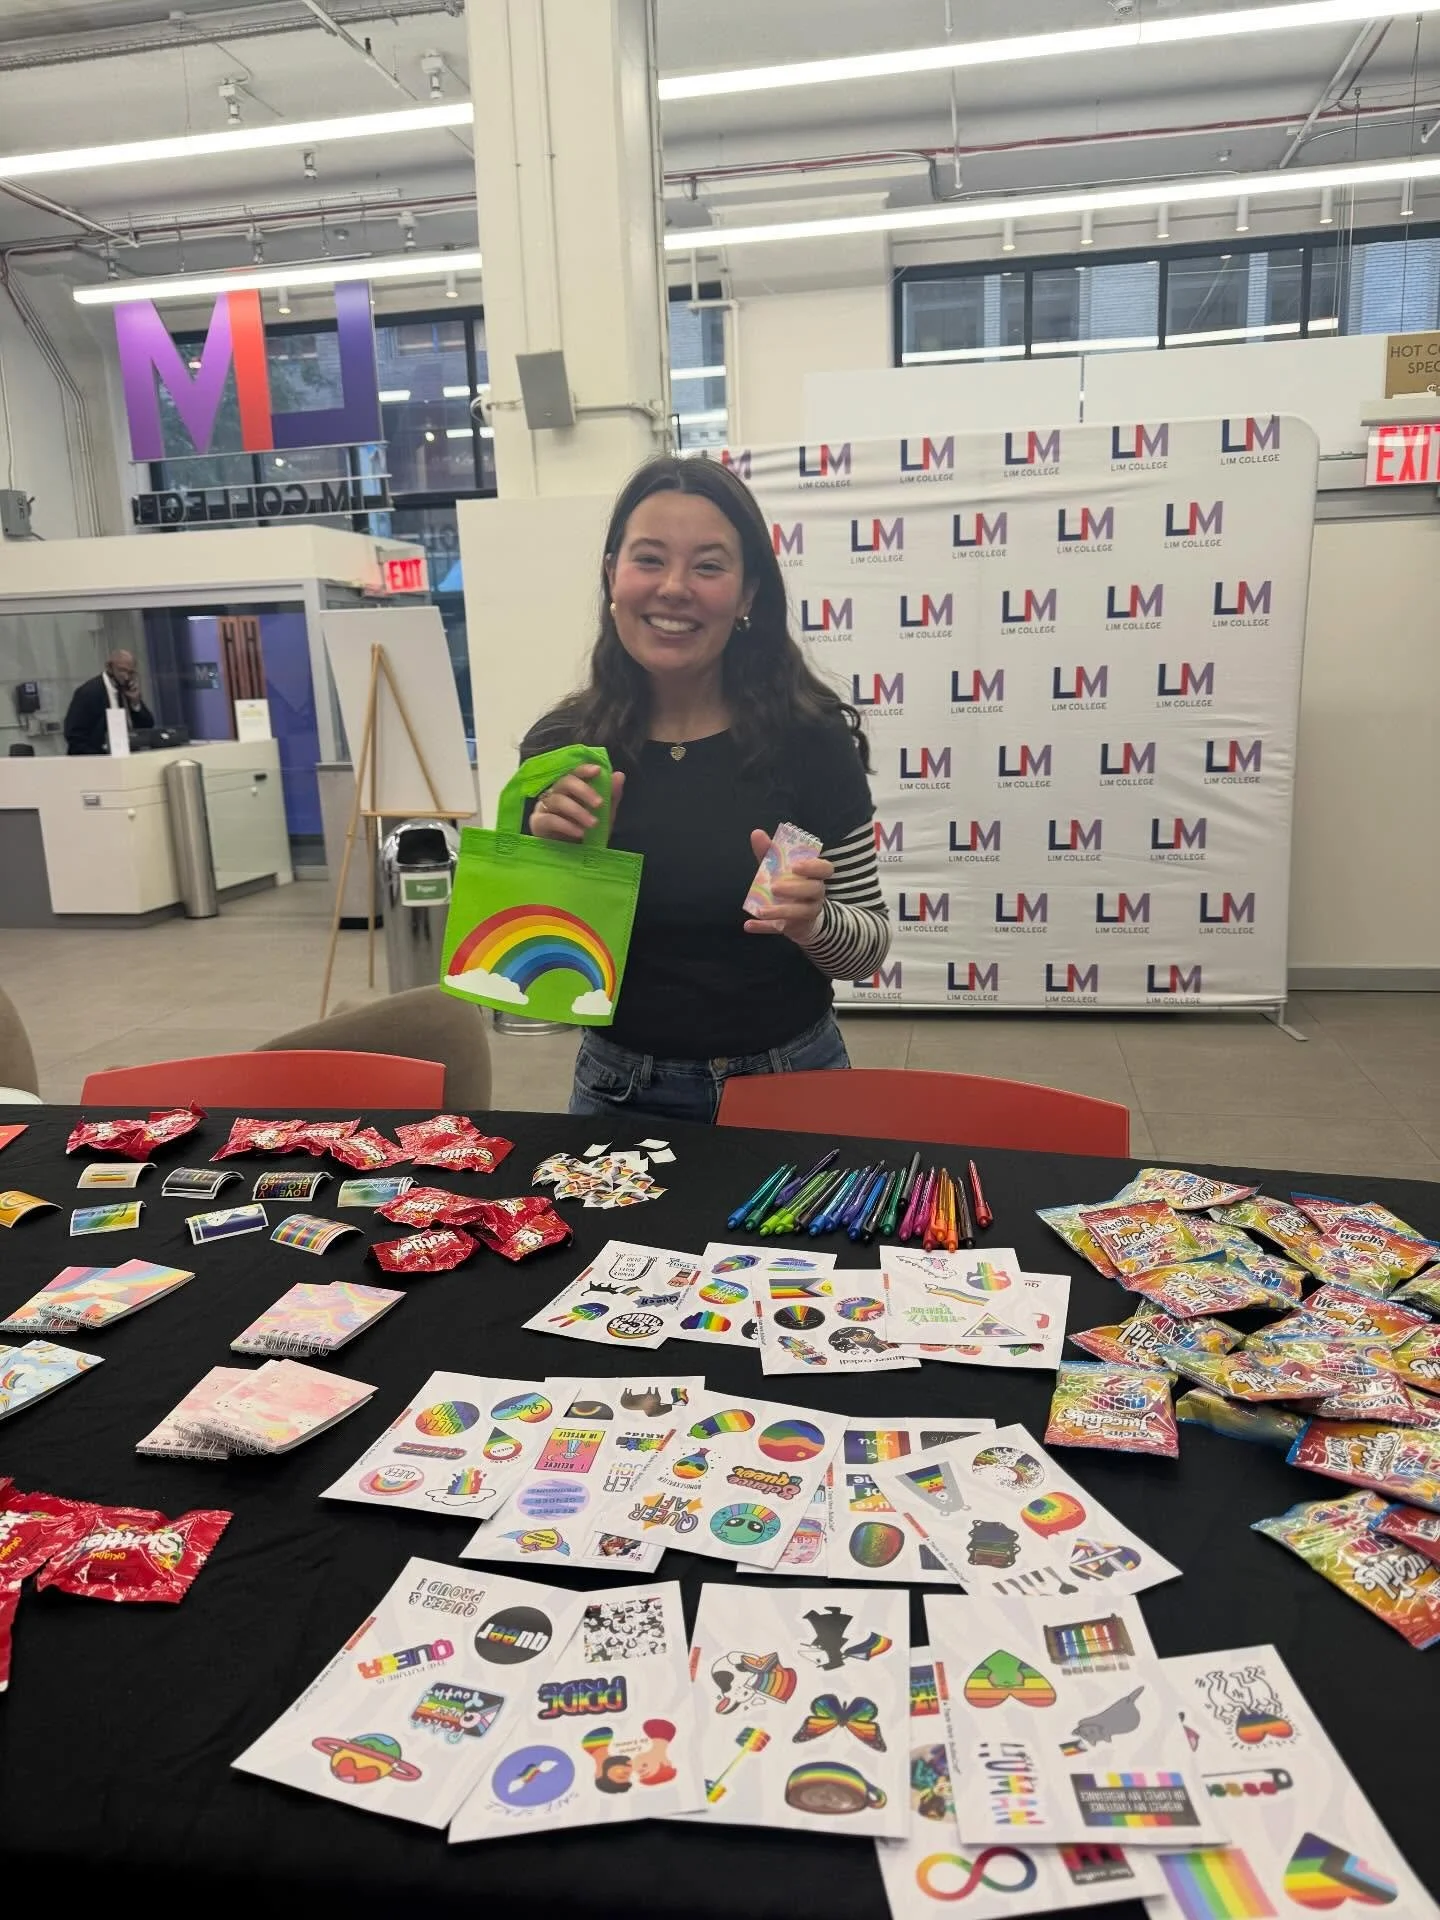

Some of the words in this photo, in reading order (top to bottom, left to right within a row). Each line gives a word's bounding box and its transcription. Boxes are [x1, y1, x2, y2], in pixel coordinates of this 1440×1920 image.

[1390, 345, 1423, 358] HOT
[1239, 455, 1279, 463] COLLEGE
[1128, 462, 1167, 470] COLLEGE
[1021, 467, 1059, 476] COLLEGE
[915, 474, 953, 482] COLLEGE
[814, 480, 851, 488] COLLEGE
[1182, 539, 1222, 547] COLLEGE
[1074, 544, 1112, 552] COLLEGE
[867, 555, 904, 563] COLLEGE
[388, 558, 421, 590] EXIT
[1018, 626, 1055, 634] COLLEGE
[1123, 622, 1161, 630] COLLEGE
[916, 630, 952, 638] COLLEGE
[802, 636, 816, 644] LIM
[817, 634, 852, 642] COLLEGE
[558, 1430, 586, 1439] MYSELF
[543, 1461, 575, 1470] BELIEVE
[732, 1466, 789, 1486] queer
[726, 1475, 800, 1500] Science
[628, 1503, 699, 1534] QUEER
[408, 1591, 422, 1604] &
[422, 1595, 478, 1618] QUEER
[476, 1623, 550, 1652] queer
[357, 1639, 455, 1680] QUEER
[537, 1676, 627, 1719] PRIDE
